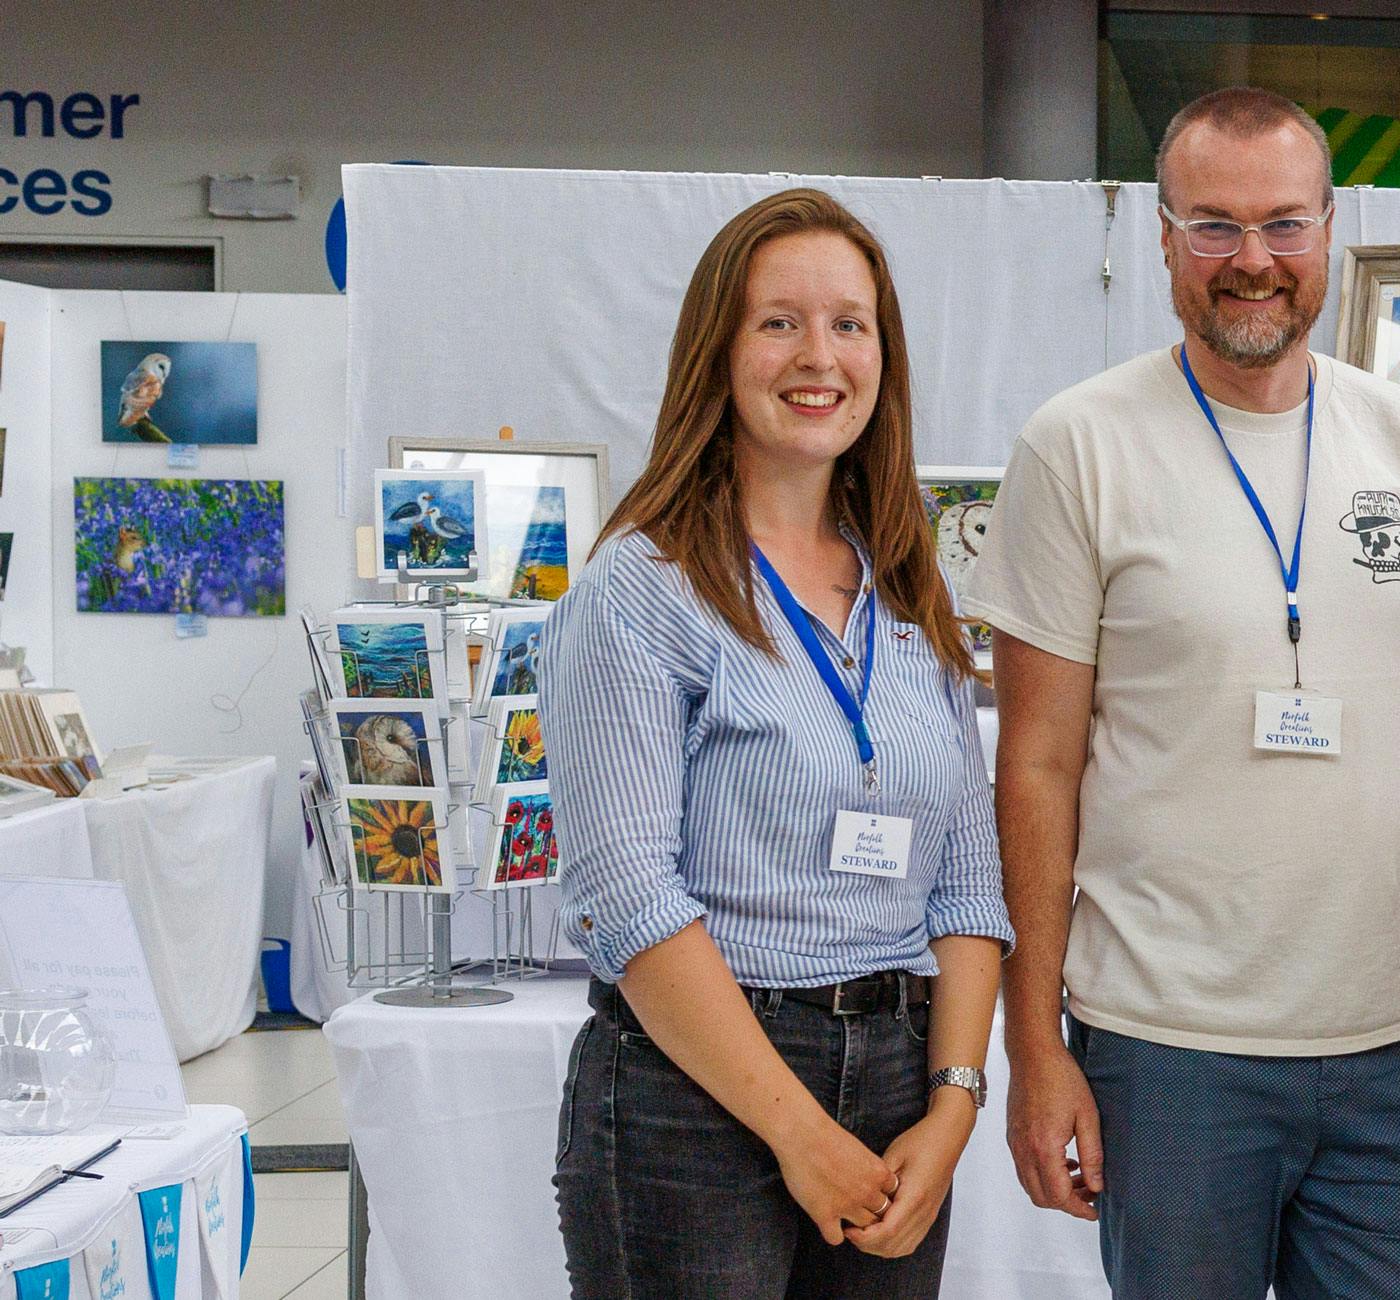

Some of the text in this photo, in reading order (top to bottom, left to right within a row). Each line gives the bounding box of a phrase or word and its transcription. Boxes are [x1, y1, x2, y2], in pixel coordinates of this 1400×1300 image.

[0, 91, 140, 139] mer
[1265, 733, 1329, 747] STEWARD
[841, 855, 897, 870] STEWARD
